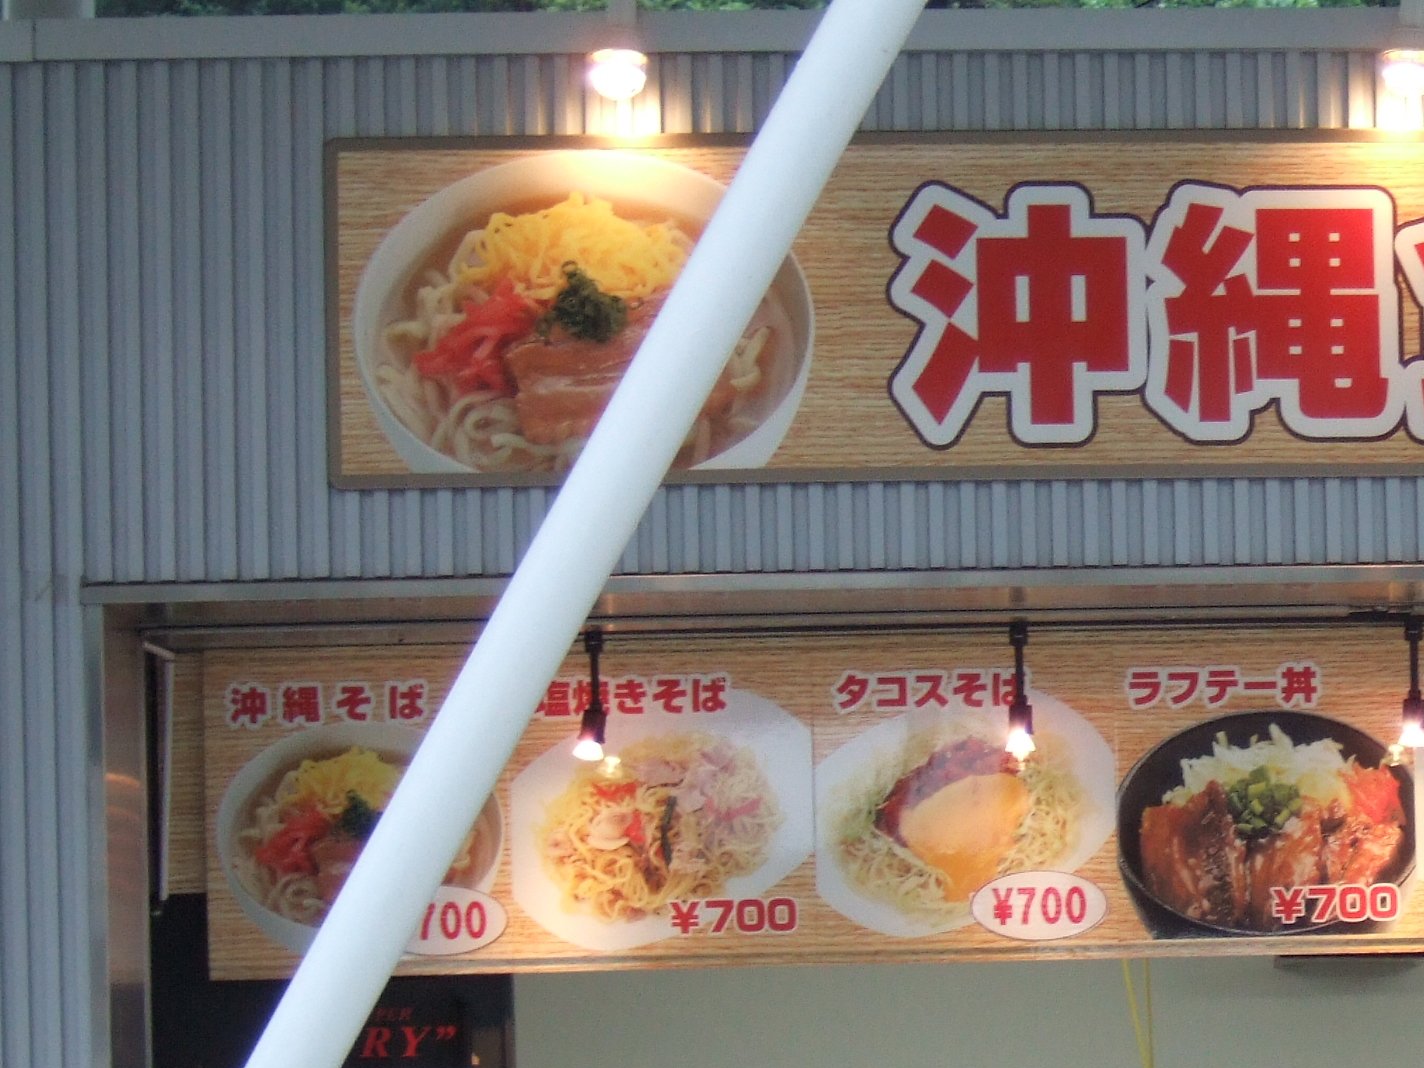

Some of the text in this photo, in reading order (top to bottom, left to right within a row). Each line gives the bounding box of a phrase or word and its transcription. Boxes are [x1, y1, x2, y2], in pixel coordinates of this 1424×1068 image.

[231, 680, 424, 722] 沖縄そば
[1128, 665, 1318, 704] ラフテー丼
[670, 897, 797, 933] ¥700
[994, 888, 1088, 925] ¥700
[1272, 884, 1400, 922] ¥700
